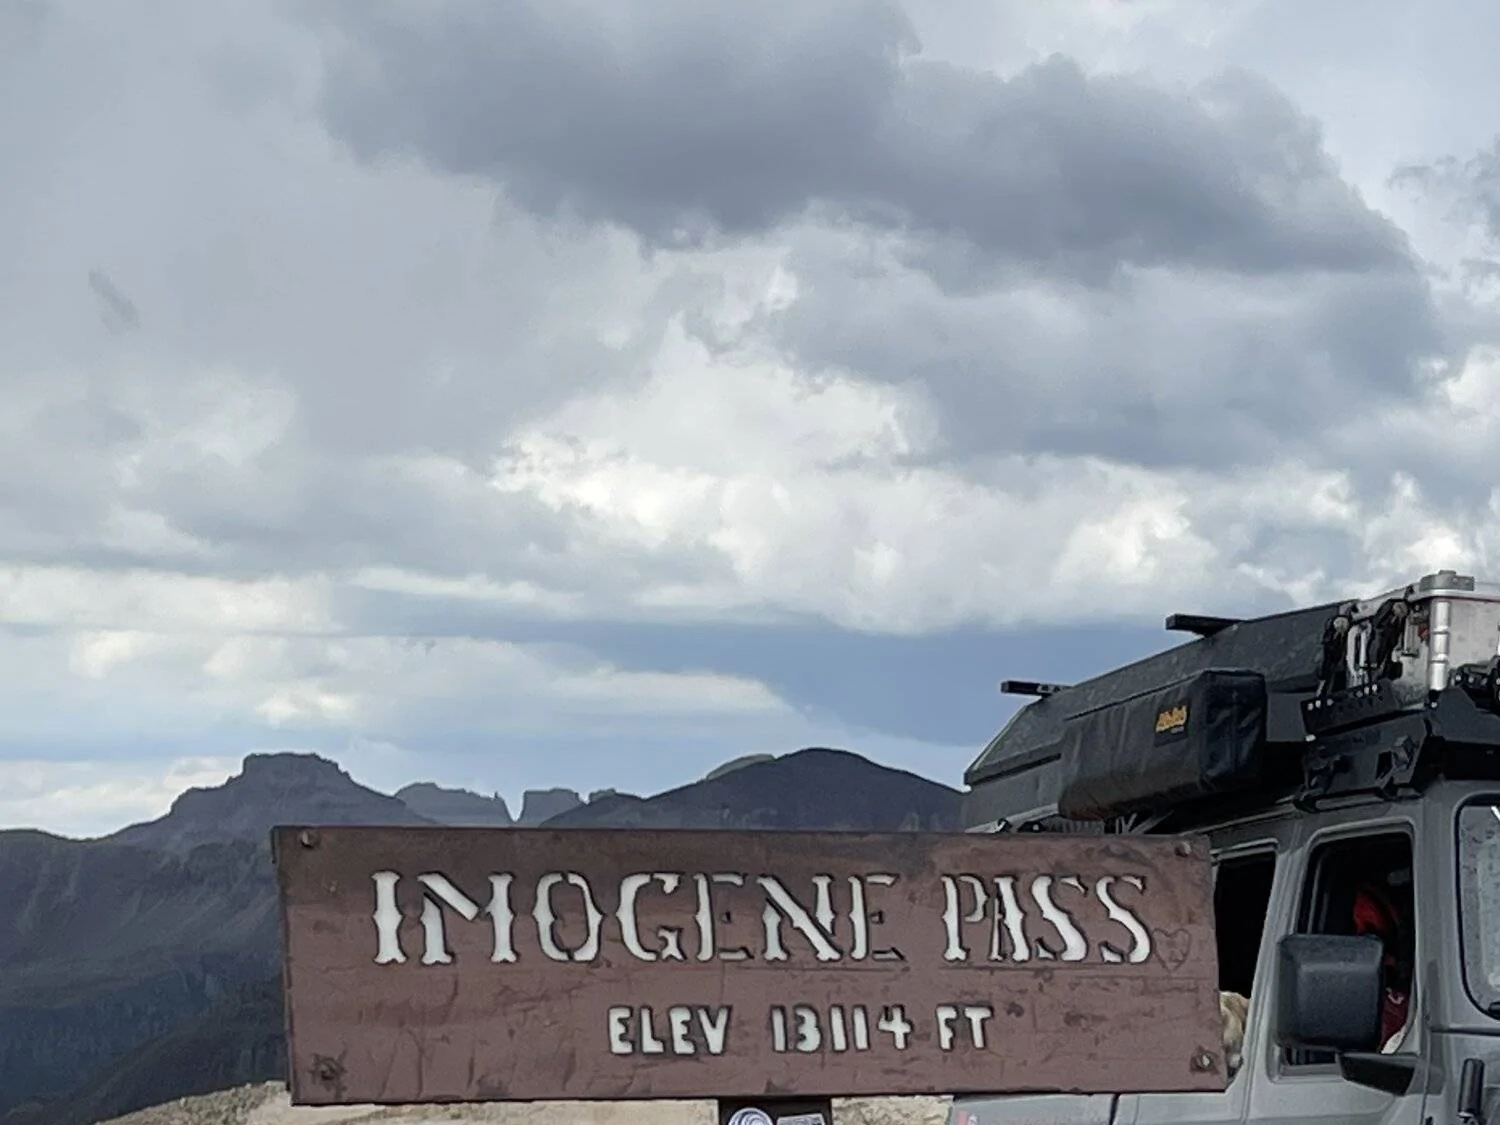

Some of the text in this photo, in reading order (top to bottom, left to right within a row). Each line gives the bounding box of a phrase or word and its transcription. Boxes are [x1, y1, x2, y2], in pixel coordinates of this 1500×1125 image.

[370, 870, 1153, 965] IMOGENE PASS
[607, 1003, 994, 1055] ELEV 13114 FT
